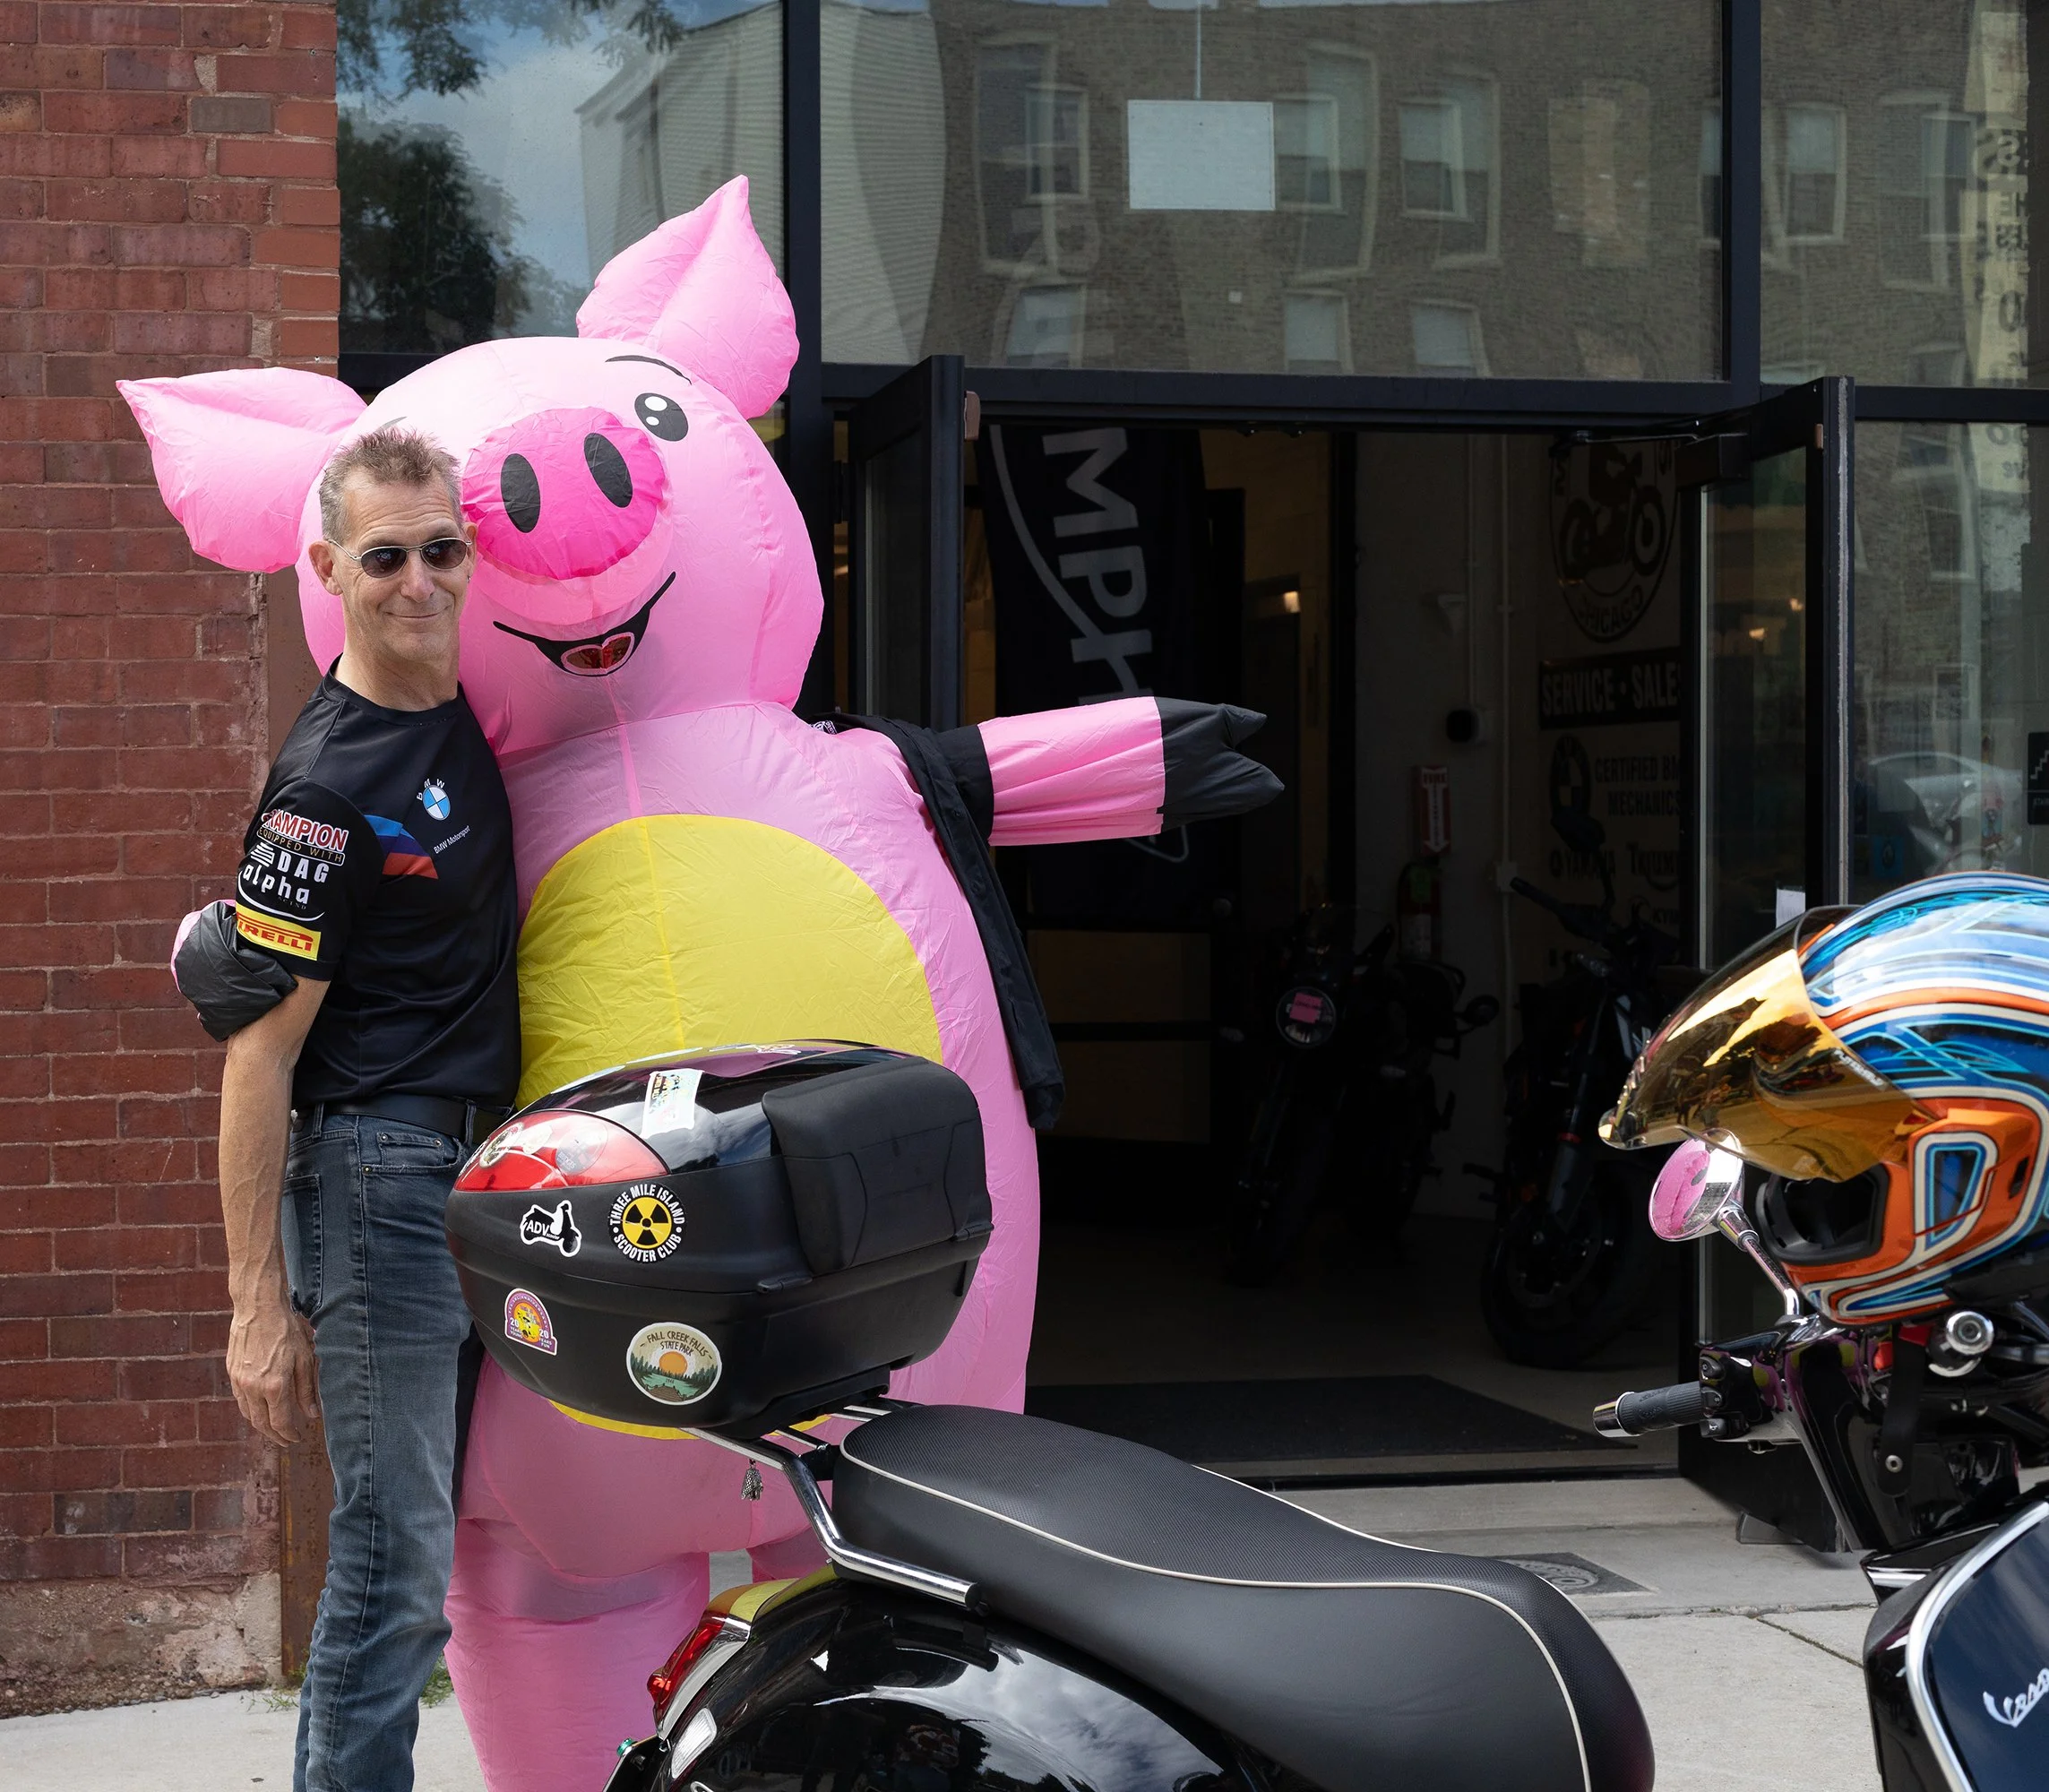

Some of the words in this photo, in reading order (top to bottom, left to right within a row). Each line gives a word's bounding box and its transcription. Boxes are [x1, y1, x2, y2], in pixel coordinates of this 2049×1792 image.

[1542, 668, 1616, 717] SERVICE
[1631, 661, 1681, 710] SALE
[1595, 756, 1658, 783] CERTIFIED
[259, 827, 302, 851] EQUIPPED
[310, 847, 342, 862] WITH
[434, 840, 448, 854] BMW
[447, 825, 470, 846] Motorsport
[277, 850, 330, 883] DAG
[243, 865, 310, 904] alpha
[610, 1192, 632, 1225] THREE
[630, 1184, 656, 1198] MILE
[656, 1187, 685, 1224] ISLAND
[526, 1219, 549, 1236] ADV
[614, 1234, 656, 1262] SCOOTER
[657, 1234, 682, 1259] CLUB
[510, 1317, 520, 1328] 20
[539, 1328, 549, 1339] 20
[647, 1331, 665, 1343] FALL
[667, 1331, 690, 1342] CREEK
[689, 1338, 709, 1357] FALLS
[660, 1340, 678, 1350] STATE
[678, 1343, 694, 1357] PARK
